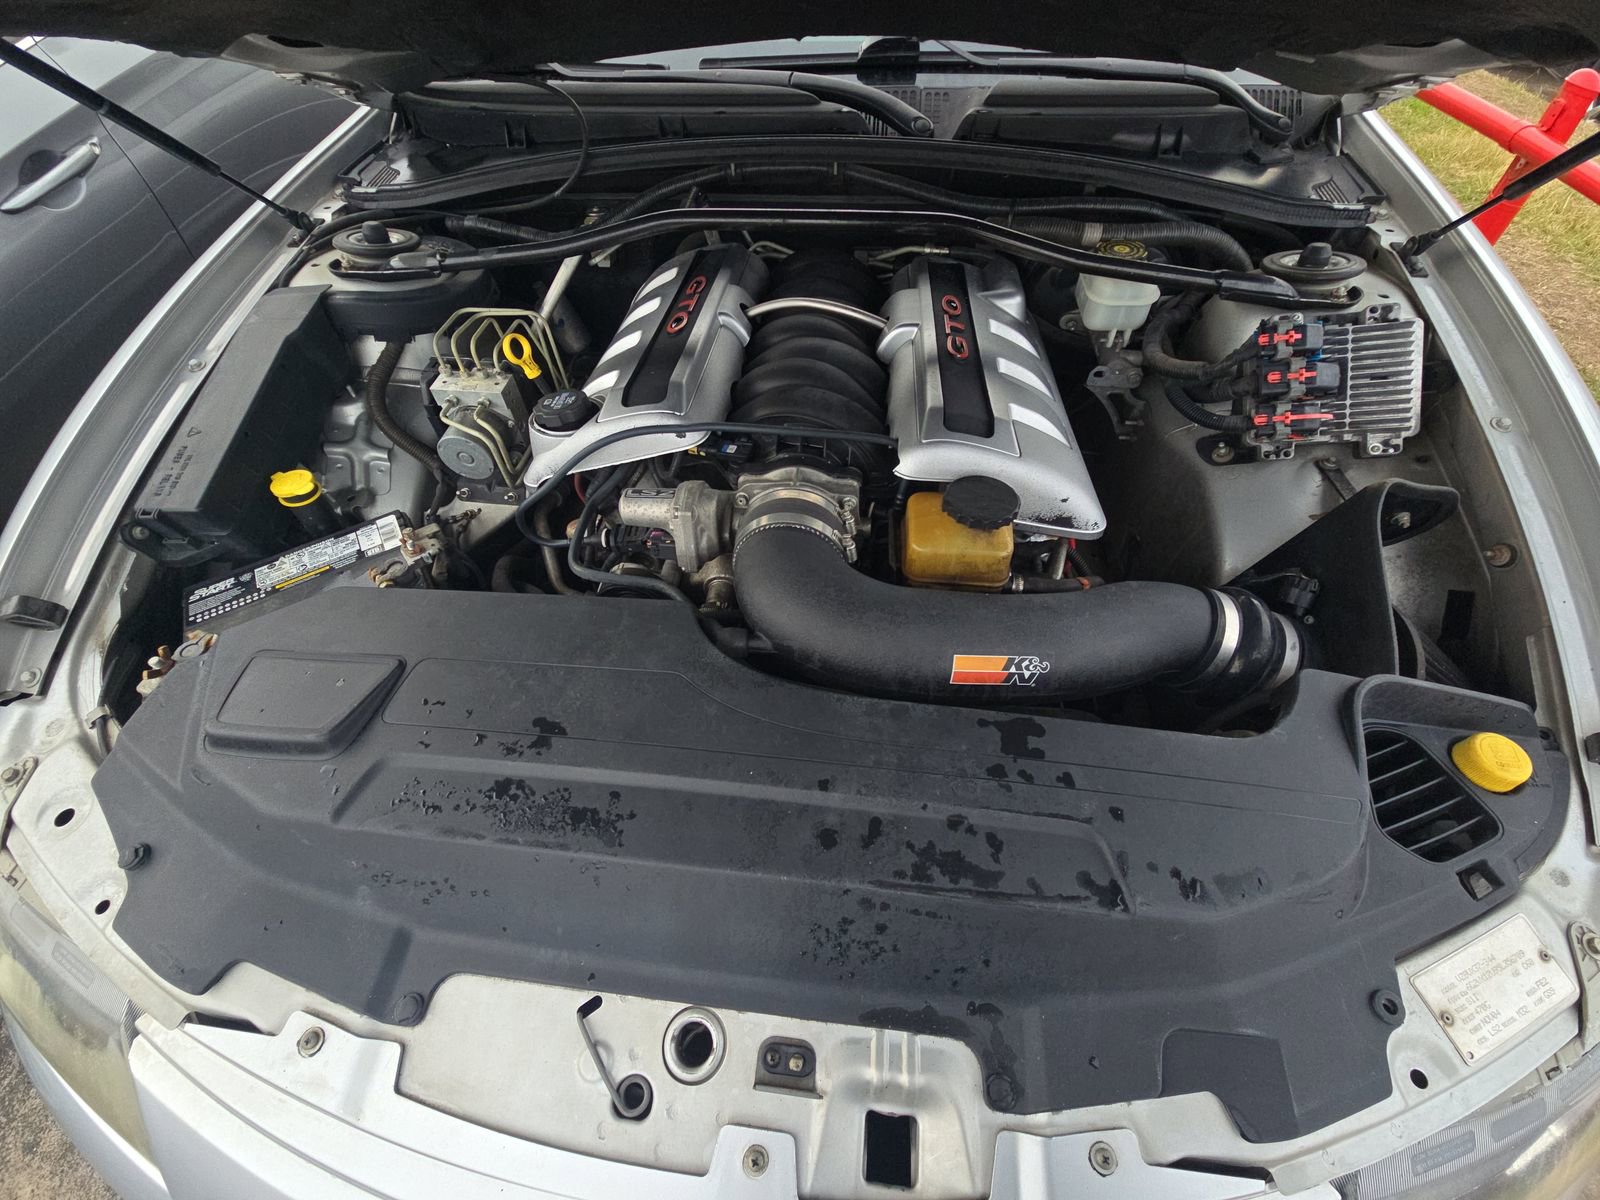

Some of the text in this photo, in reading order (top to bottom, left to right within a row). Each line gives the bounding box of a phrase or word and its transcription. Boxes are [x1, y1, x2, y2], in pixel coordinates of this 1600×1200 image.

[666, 275, 708, 334] GTO
[941, 294, 969, 359] GTO
[1001, 655, 1051, 686] K&N
[1486, 1022, 1503, 1037] LS2
